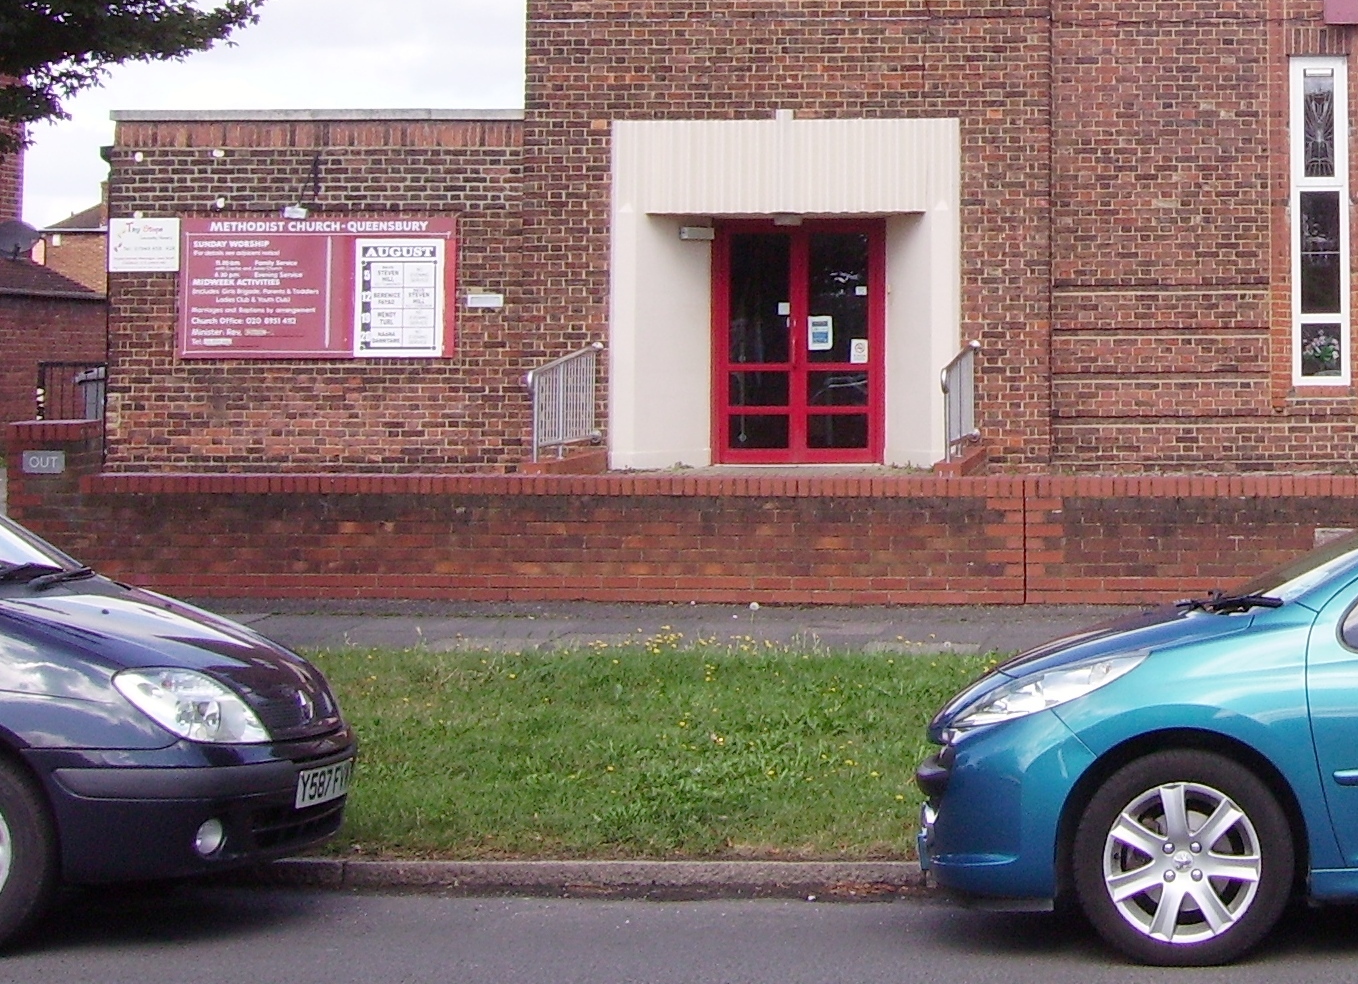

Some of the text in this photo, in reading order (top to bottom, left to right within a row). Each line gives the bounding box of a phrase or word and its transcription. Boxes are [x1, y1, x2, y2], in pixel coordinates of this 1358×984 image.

[209, 221, 285, 232] METHODIST
[288, 221, 340, 232] CHURCH
[347, 220, 429, 233] QUEENSBURY
[193, 240, 270, 248] SUNDAY WORSHIP
[365, 247, 434, 257] AUGUST
[29, 456, 58, 468] OUT
[301, 769, 333, 802] Y587
